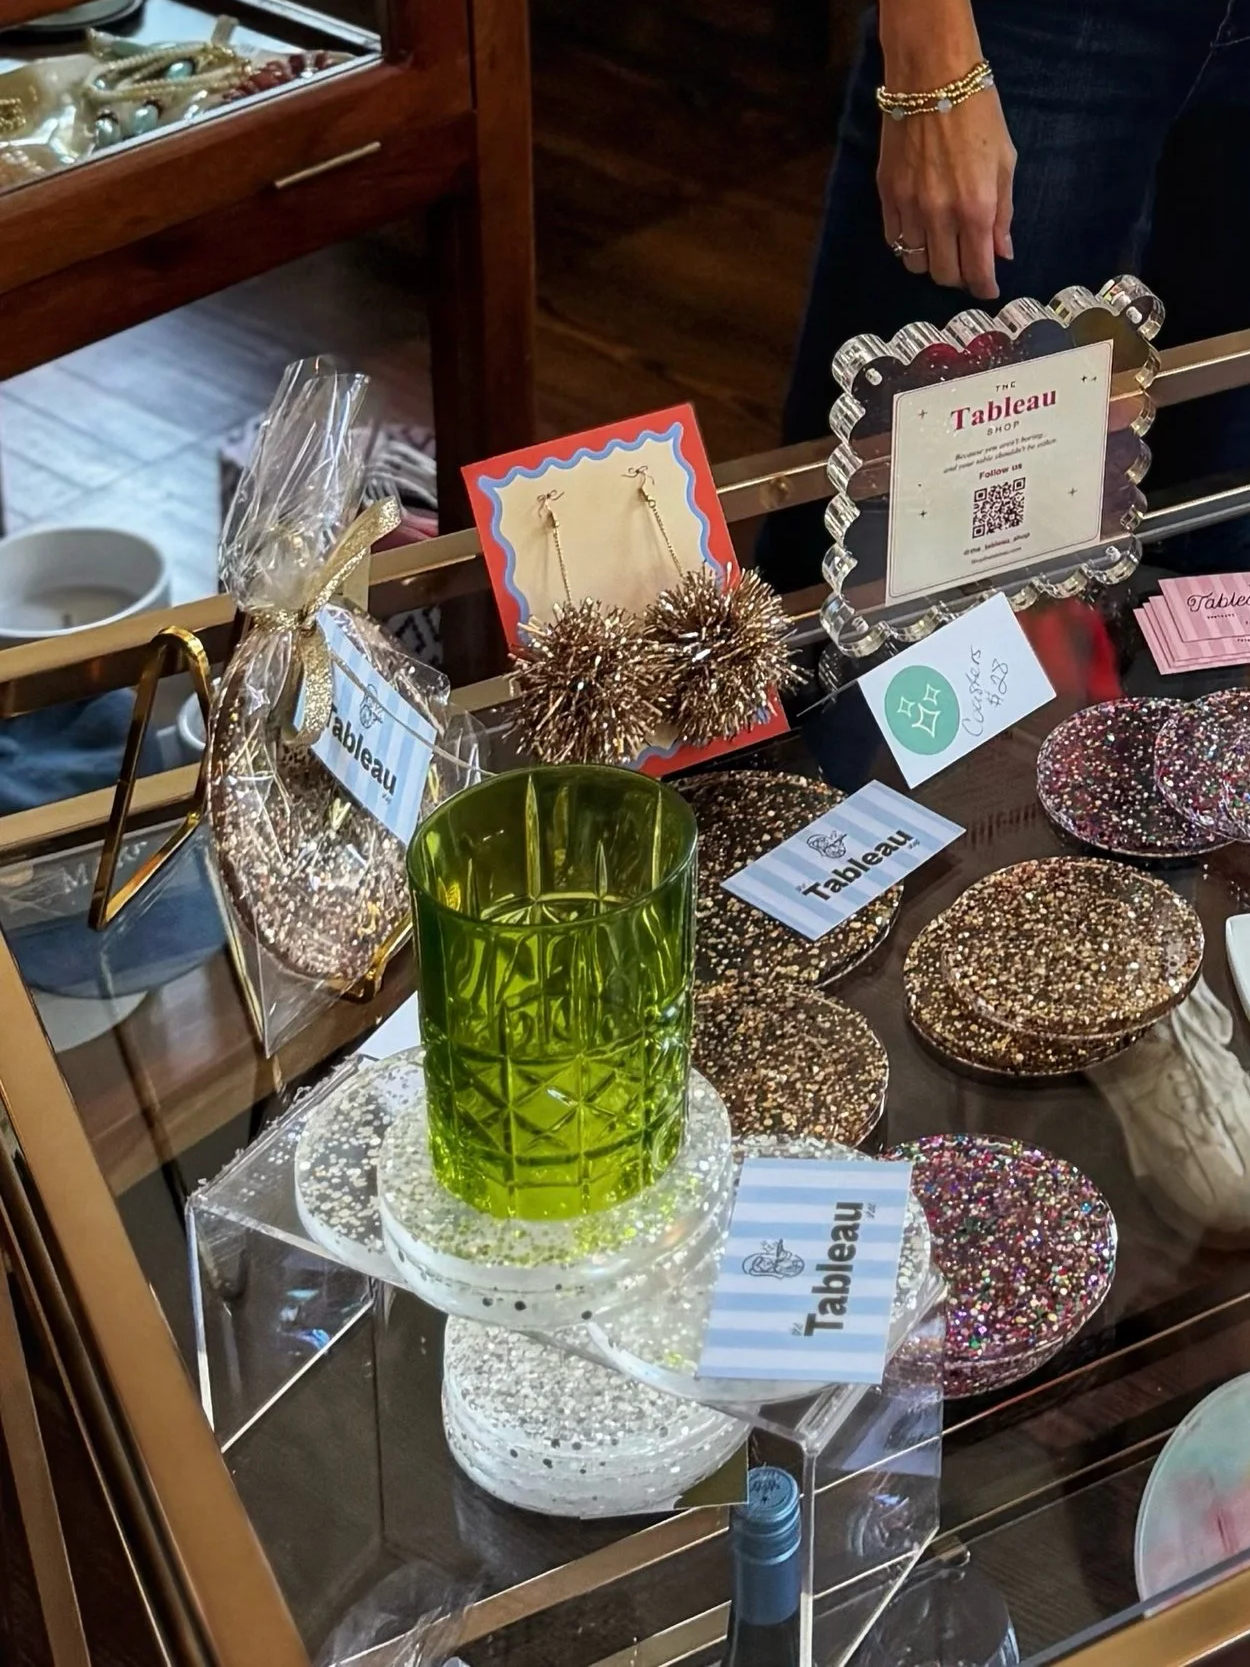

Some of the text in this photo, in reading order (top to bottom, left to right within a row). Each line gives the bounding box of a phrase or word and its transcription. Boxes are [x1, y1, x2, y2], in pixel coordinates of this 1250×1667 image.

[995, 381, 1016, 392] THE
[950, 390, 1057, 431] Tableau
[986, 420, 1020, 436] SHOP
[978, 463, 1023, 480] Follow us
[961, 644, 983, 738] Coasters
[801, 829, 916, 902] Tableau
[803, 1201, 864, 1337] Tableau
